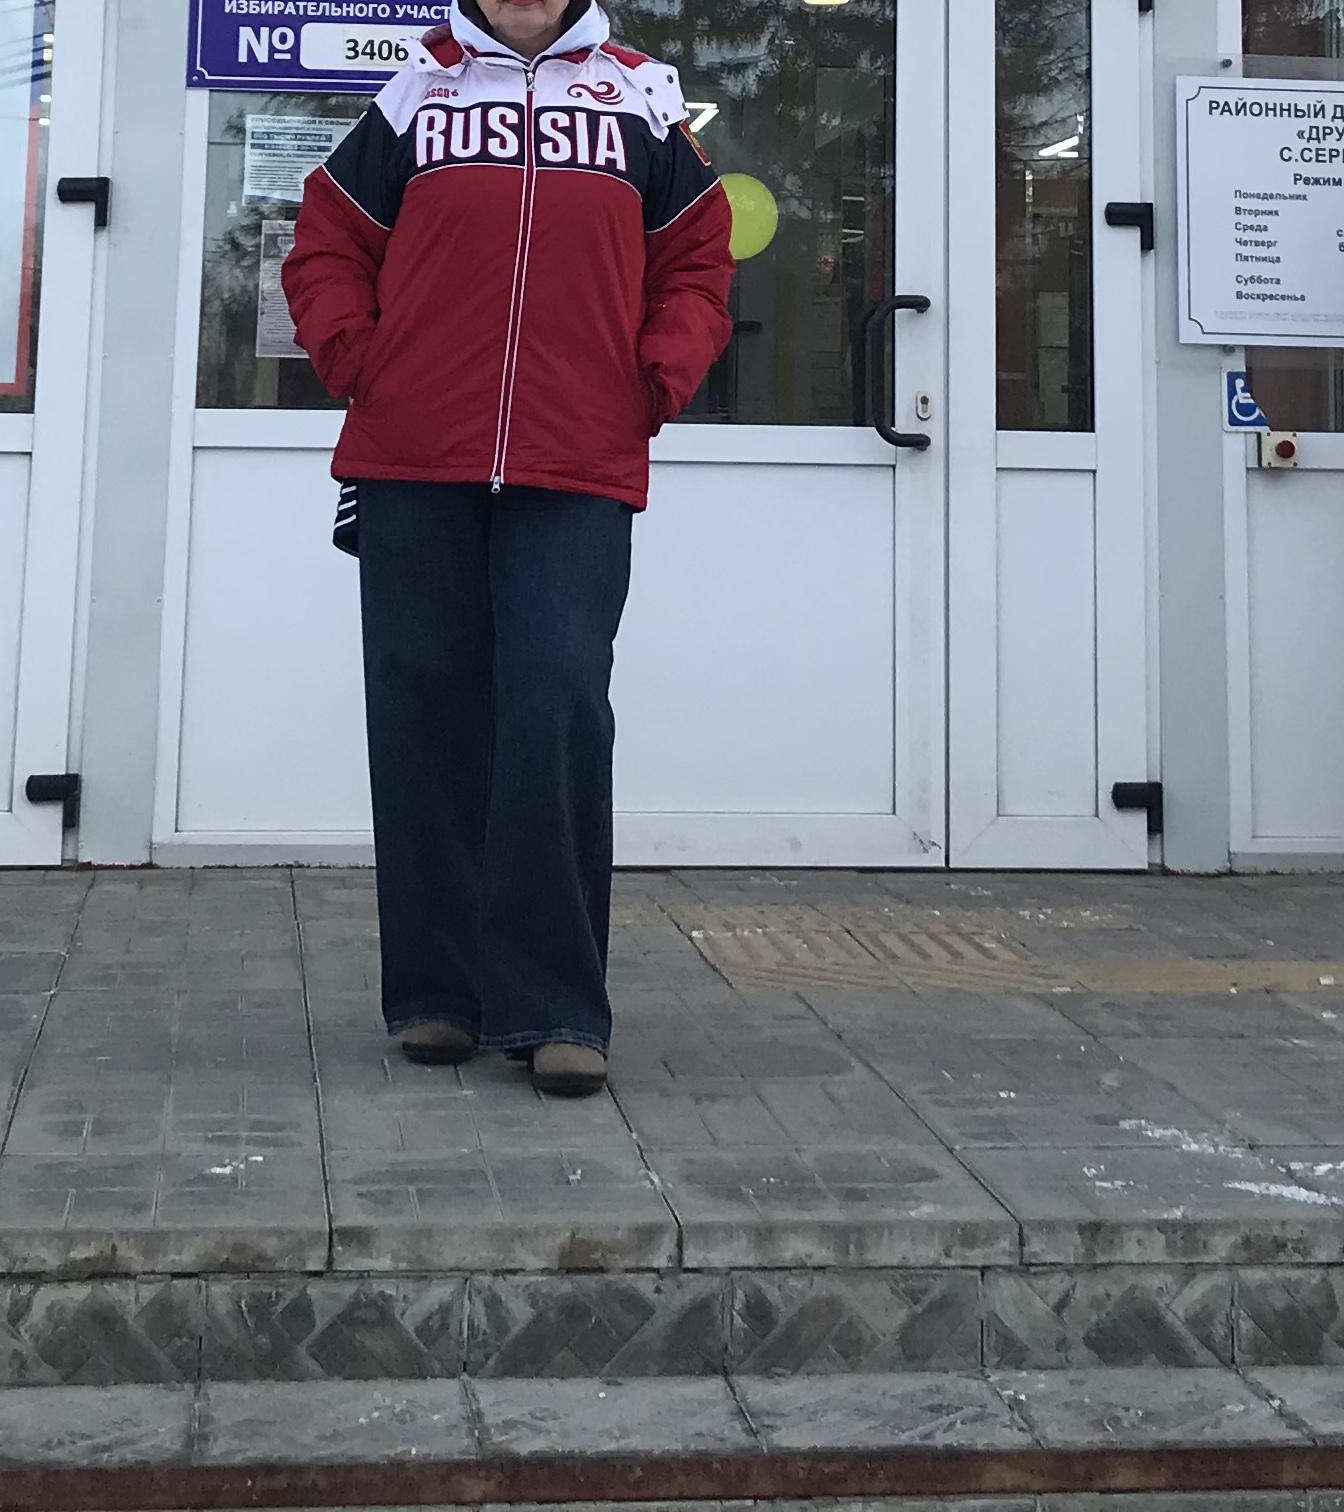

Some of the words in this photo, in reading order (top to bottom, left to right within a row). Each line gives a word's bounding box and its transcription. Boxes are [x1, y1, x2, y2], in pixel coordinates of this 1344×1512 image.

[224, 0, 390, 18] ИЗБИРАТЕЛЬНОГО
[345, 38, 409, 61] 3406
[1208, 98, 1325, 120] РАЙОННЫЙ
[416, 106, 627, 173] RUSSIA
[1293, 173, 1342, 187] Режим
[1234, 190, 1308, 201] Понедельник
[1234, 206, 1279, 218] Вторник
[1234, 222, 1268, 233] Среда
[1235, 237, 1278, 249] Четверг
[1235, 253, 1281, 264] Пятница
[1235, 274, 1281, 286] Суббота
[1236, 291, 1306, 302] Воскресенье
